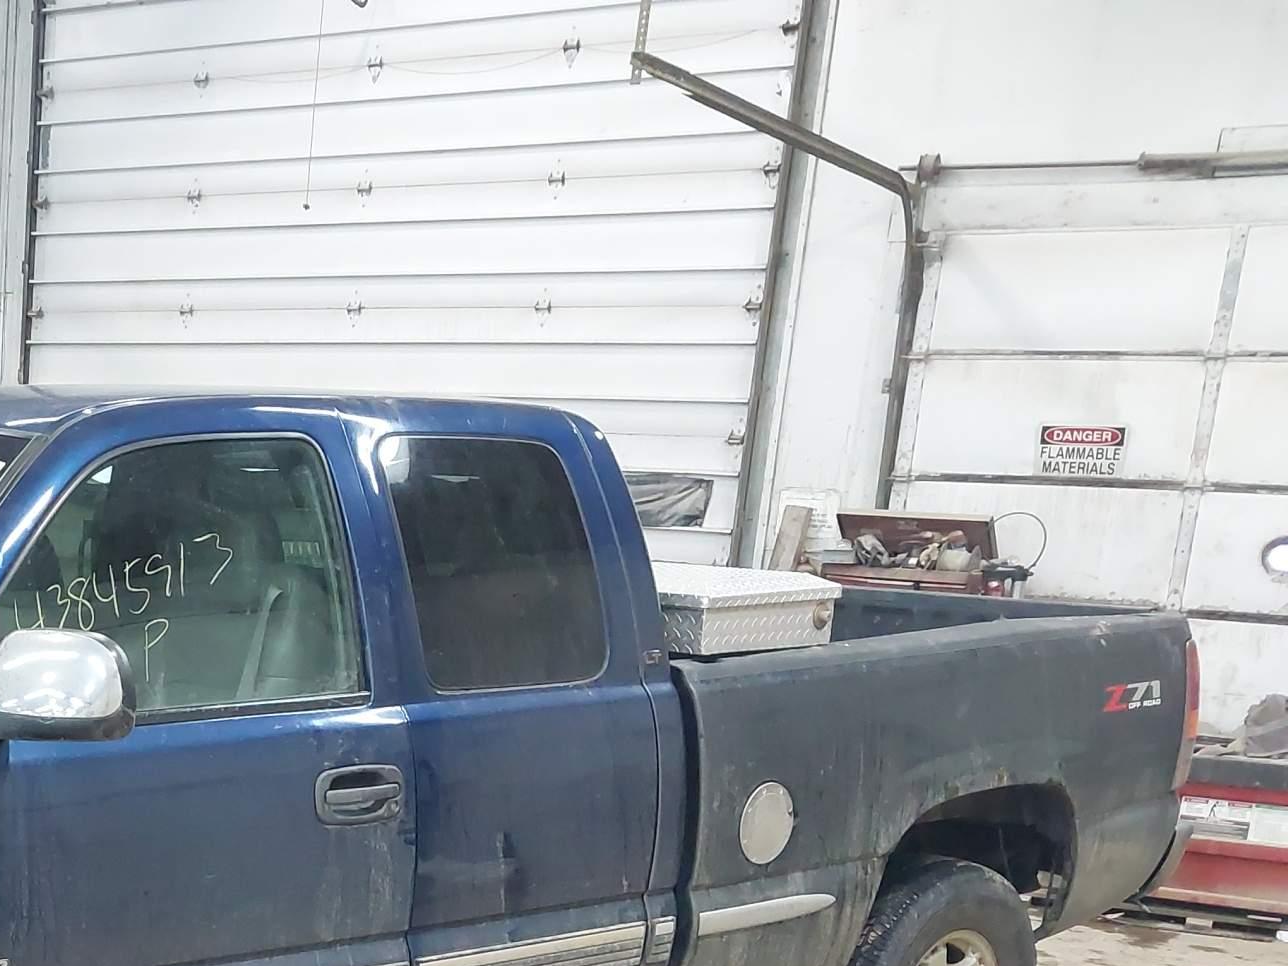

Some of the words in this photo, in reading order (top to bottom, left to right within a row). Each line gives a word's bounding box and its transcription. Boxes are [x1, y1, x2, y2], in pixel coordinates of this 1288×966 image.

[1053, 430, 1112, 442] DANGER
[1040, 446, 1121, 461] FLAMMABLE
[1042, 461, 1116, 475] MATERIALS
[14, 533, 233, 631] 43845913
[144, 618, 169, 682] P
[1104, 680, 1161, 712] Z71
